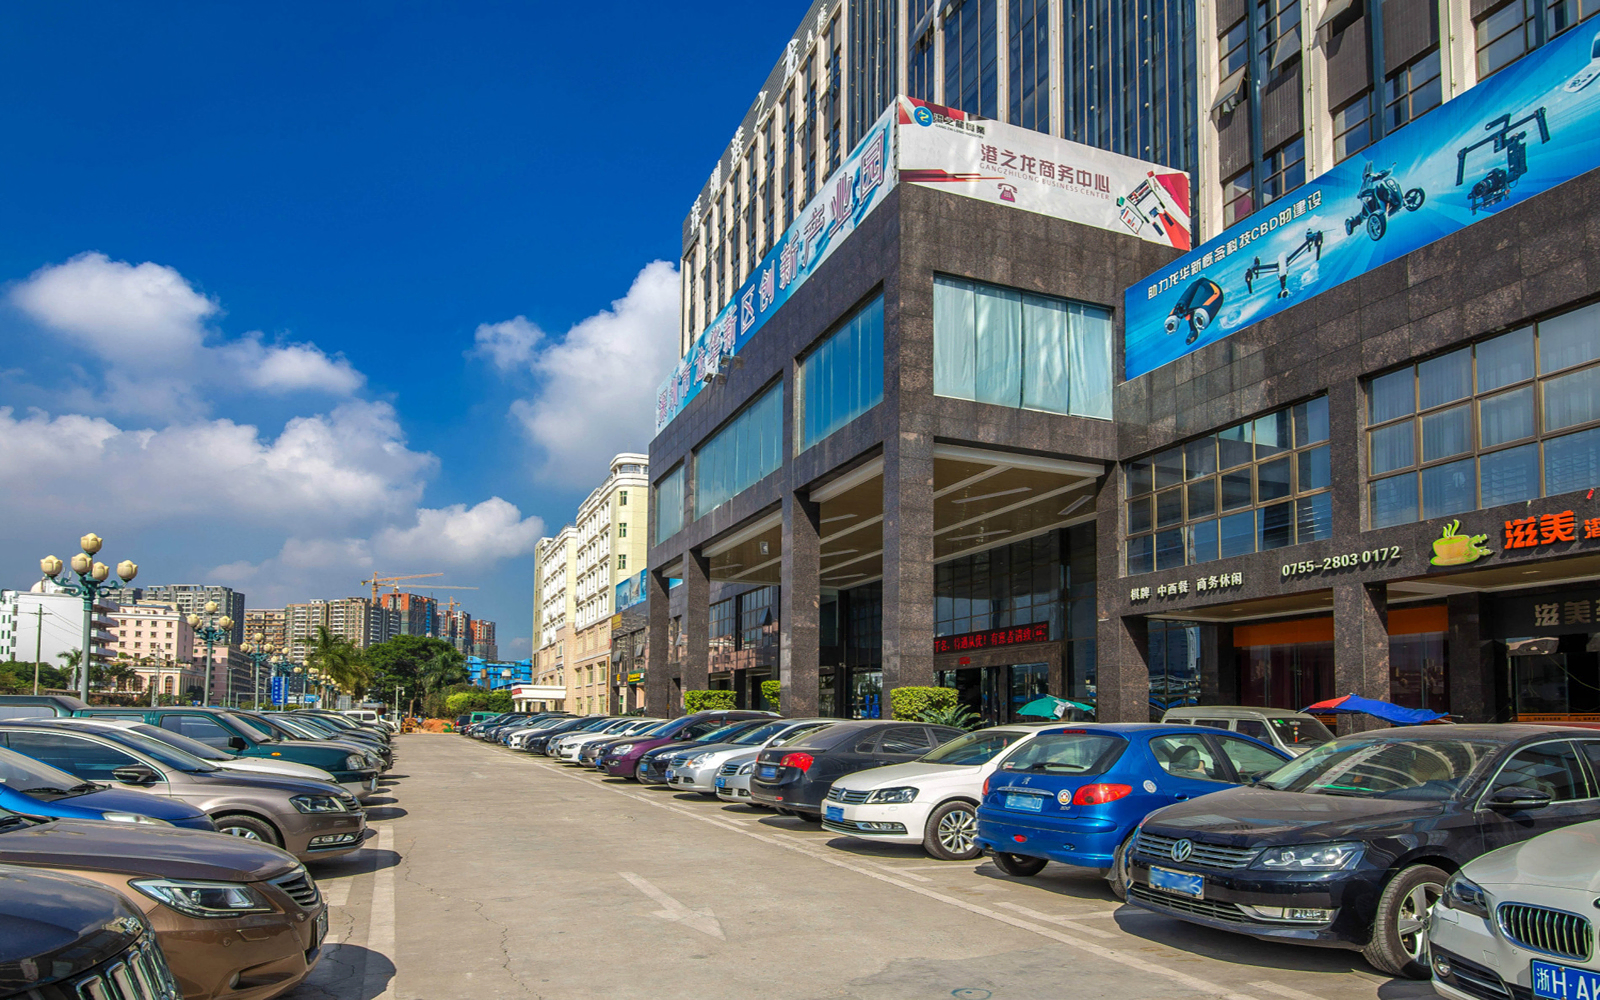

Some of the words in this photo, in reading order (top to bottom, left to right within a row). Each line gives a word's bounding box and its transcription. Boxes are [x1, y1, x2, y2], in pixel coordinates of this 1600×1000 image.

[979, 163, 1040, 184] GANGZHILONG
[1041, 177, 1079, 193] BUSINESS
[1080, 188, 1110, 200] CENTER
[980, 143, 1110, 194] 港之龙商务中心
[1147, 189, 1322, 301] 助力龙华新概念科技CBD的建设
[657, 128, 886, 427] 深圳市龙华新区创新产业园
[1504, 509, 1576, 550] 滋美
[1361, 545, 1401, 564] 0172
[1130, 586, 1151, 601] 棋牌
[1157, 579, 1189, 597] 中西餐
[1196, 571, 1243, 592] 商务休闲
[1534, 600, 1600, 627] 滋美
